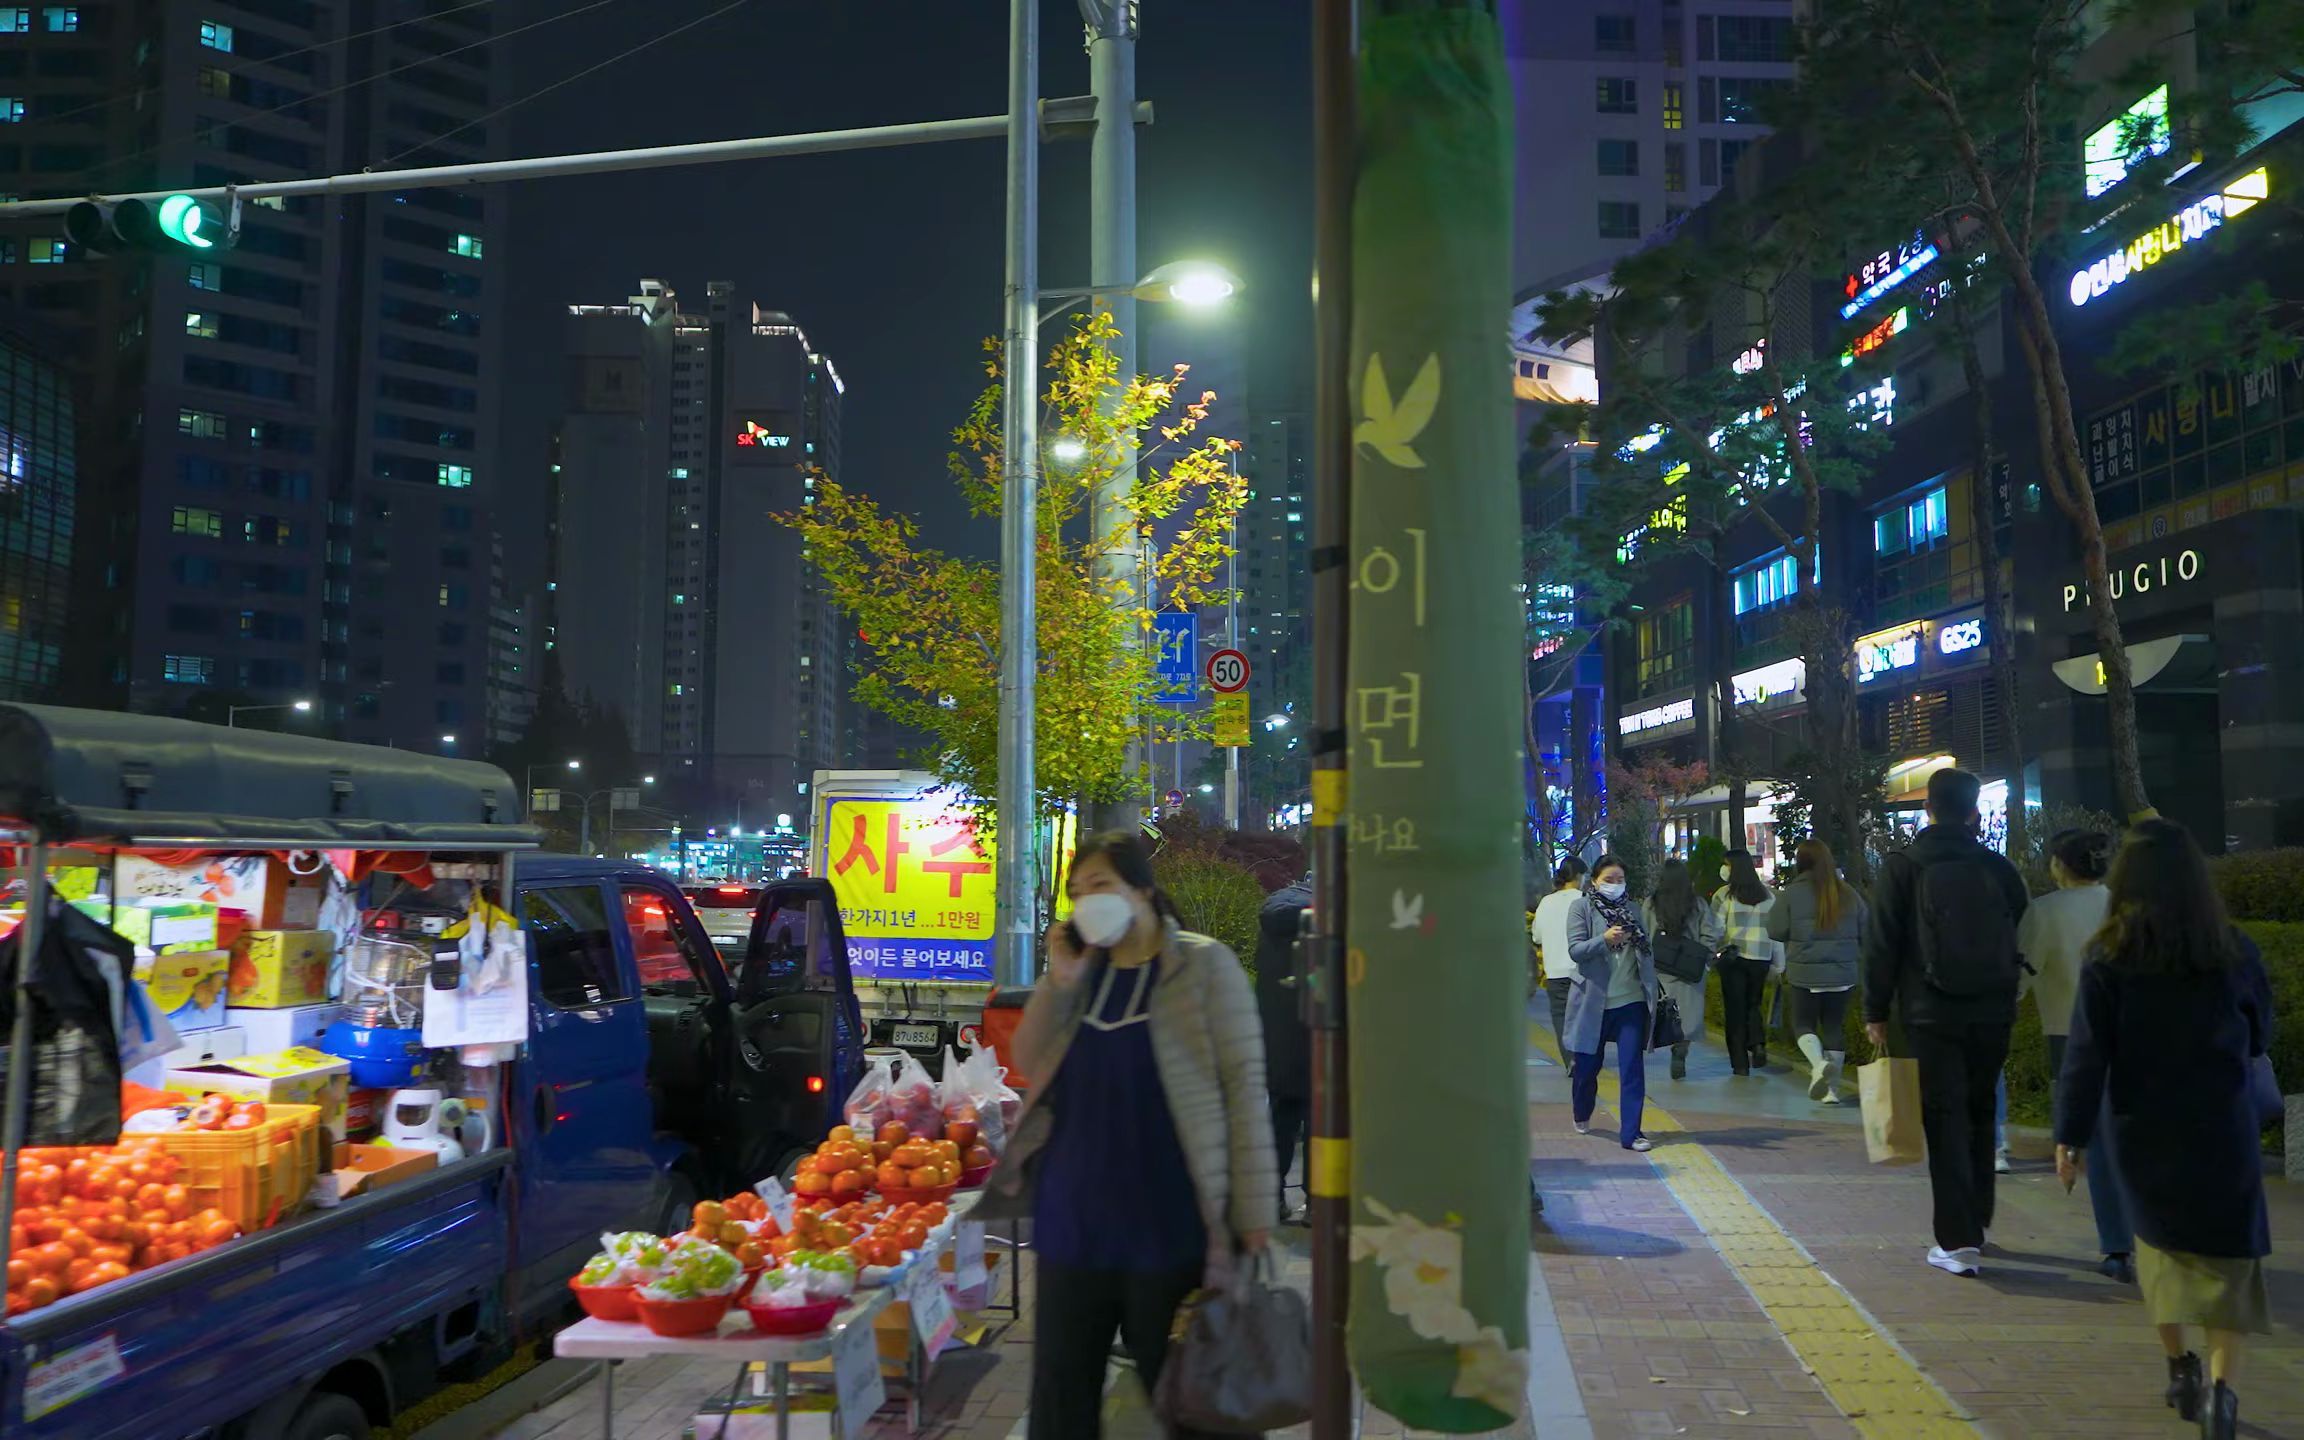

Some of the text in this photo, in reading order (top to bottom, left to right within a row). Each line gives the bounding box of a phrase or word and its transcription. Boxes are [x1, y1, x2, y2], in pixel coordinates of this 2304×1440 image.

[1861, 251, 1890, 286] 약국
[737, 433, 789, 447] SK VIEW
[2063, 549, 2197, 612] PUGIO
[1940, 619, 1982, 654] GS25
[1215, 659, 1241, 683] 50
[847, 946, 991, 969] 엇이든 물어보세요
